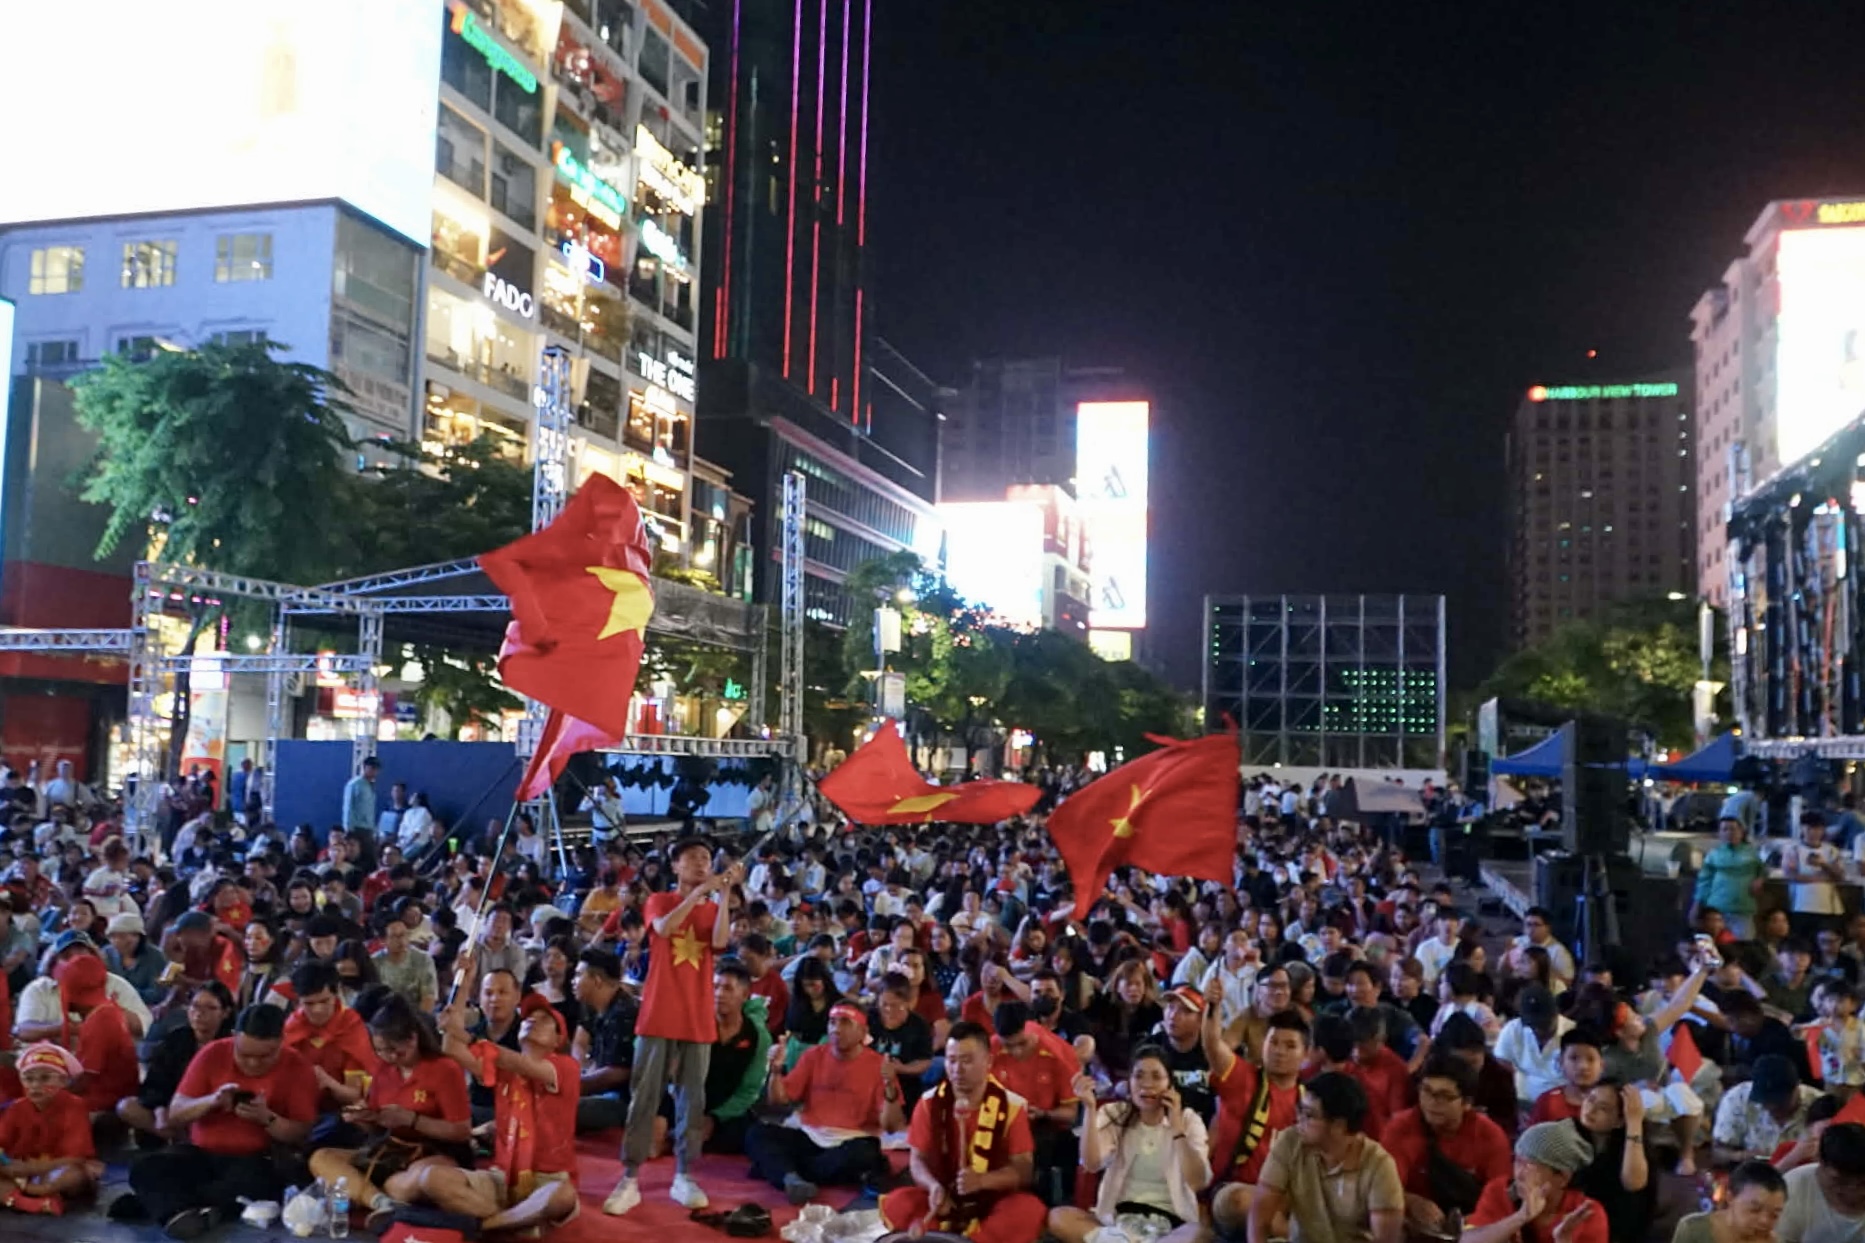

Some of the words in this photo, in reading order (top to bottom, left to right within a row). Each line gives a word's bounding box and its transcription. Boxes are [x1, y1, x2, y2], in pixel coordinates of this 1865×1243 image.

[484, 271, 533, 318] FADO
[638, 351, 667, 388] THE
[667, 368, 695, 402] ONE
[1633, 383, 1678, 397] TOWER
